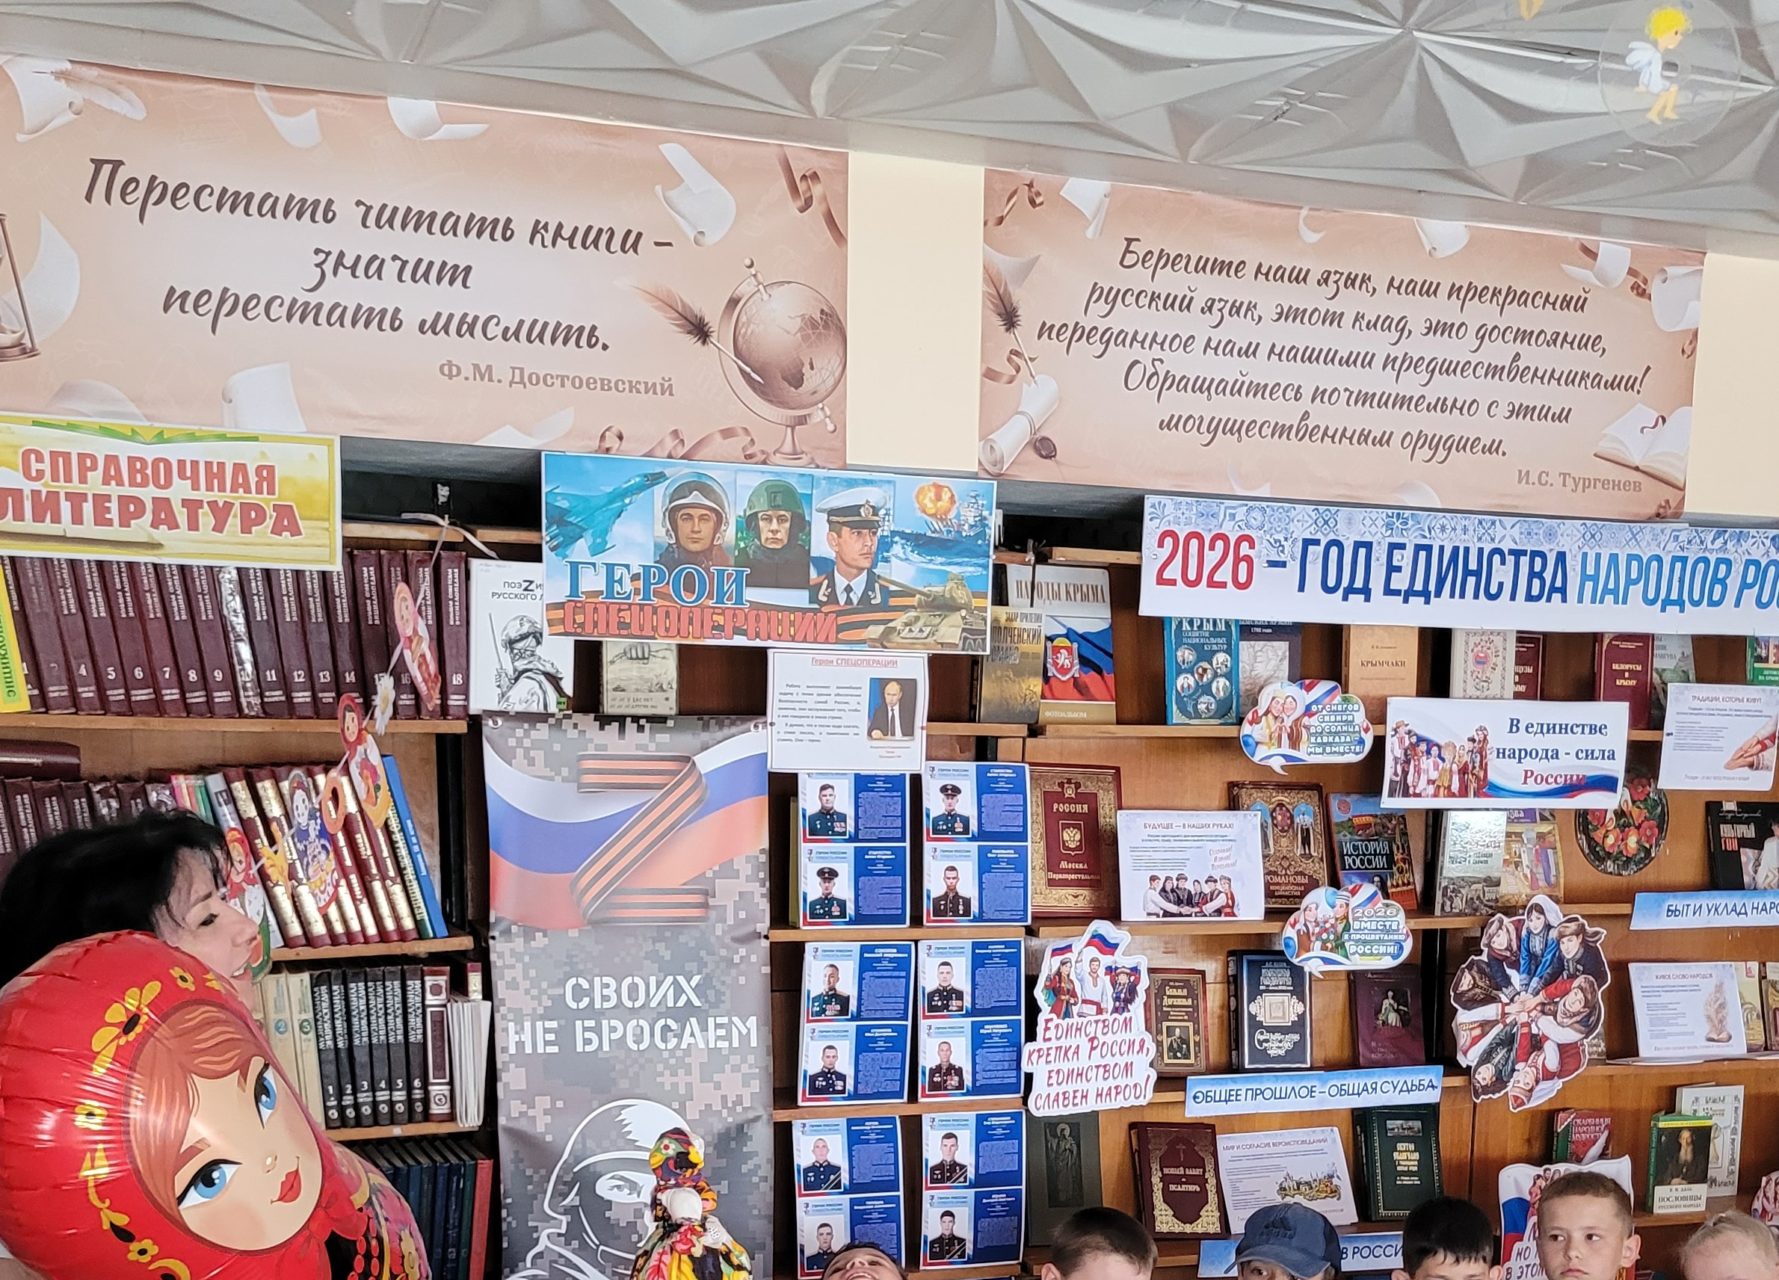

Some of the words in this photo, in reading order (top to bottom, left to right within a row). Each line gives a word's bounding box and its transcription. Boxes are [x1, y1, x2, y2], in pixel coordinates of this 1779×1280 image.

[83, 156, 337, 229] Перестать
[353, 195, 517, 244] читать
[529, 214, 643, 257] книги
[302, 243, 472, 293] значит
[1120, 237, 1246, 284] Берегите
[1254, 259, 1310, 289] наш
[1316, 262, 1379, 300] язык,
[1387, 274, 1440, 301] наш
[1447, 279, 1590, 319] прекрасный
[163, 281, 403, 338] перестать
[419, 309, 610, 352] мыслить.
[1083, 282, 1197, 323] русский
[1200, 294, 1264, 330] язык,
[1271, 300, 1345, 331] этот
[1352, 309, 1413, 345] клад,
[1420, 314, 1469, 342] это
[1472, 321, 1608, 361] достояние,
[1037, 317, 1198, 364] переданное
[1203, 335, 1261, 363] нам
[1267, 339, 1372, 372] нашими
[1380, 344, 1652, 399] предшественниками!
[438, 358, 503, 388] Ф.М.
[508, 364, 676, 400] Достоевский
[1122, 356, 1304, 408] Обращайтесь
[1309, 382, 1480, 424] почтительно
[1487, 398, 1500, 419] с
[1506, 398, 1573, 427] этим
[1156, 408, 1395, 454] могущественным
[1399, 427, 1509, 466] орудием.
[20, 448, 278, 497] СПРАВОЧНАЯ
[1516, 469, 1556, 488] И.С.
[1560, 472, 1643, 496] Тургенев
[0, 487, 304, 538] ЛИТЕРАТУРА
[1155, 528, 1257, 594] 2026
[1296, 537, 1375, 604] ГОД
[1382, 537, 1570, 608] ЕДИНСТВА
[1576, 552, 1730, 613] НАРОДОВ
[563, 558, 751, 607] ГЕРОИ
[491, 591, 537, 601] РУССКОГО
[1065, 583, 1106, 604] КРЫМА
[563, 600, 837, 644] СПЕЦОПЕРАЦИИ
[1182, 618, 1227, 631] КРЫМ
[811, 657, 834, 667] Герои
[836, 658, 898, 668] СПЕЦОПЕРАЦИИ
[1360, 659, 1406, 668] КРЫМЧАКИ
[78, 664, 87, 676] 4
[107, 667, 116, 680] 5
[134, 667, 144, 680] 6
[162, 667, 171, 679] 7
[188, 669, 197, 682] 8
[214, 669, 223, 682] 9
[293, 670, 305, 682] 12
[319, 671, 331, 682] 13
[345, 671, 356, 682] 14
[452, 673, 463, 685] 18
[1311, 704, 1322, 712] ОТ
[1325, 704, 1360, 712] СНЕГОВ
[1325, 724, 1360, 733] СОЛНЦА
[1508, 717, 1520, 735] В
[1525, 719, 1608, 737] единстве
[1495, 745, 1559, 763] народа
[1575, 745, 1616, 762] сила
[1522, 768, 1587, 787] России
[1053, 803, 1088, 813] РОССИЯ
[1143, 822, 1174, 830] БУДУЩЕЕ
[1342, 840, 1389, 854] ИСТОРИЯ
[1345, 856, 1388, 869] РОССИИ
[1265, 874, 1309, 884] РОМАНОВЫ
[1353, 908, 1398, 917] 2026
[1666, 903, 1691, 918] БЫТ
[1692, 903, 1703, 917] И
[1706, 902, 1748, 918] УКЛАД
[1353, 921, 1398, 930] ВМЕСТЕ
[1349, 945, 1398, 954] РОССИИ!
[565, 975, 702, 1010] СВОИХ
[508, 1021, 559, 1054] НЕ
[575, 1016, 758, 1052] БРОСАЕМ
[1026, 1043, 1080, 1067] КРЕПКА
[345, 1085, 352, 1094] 2
[361, 1081, 369, 1091] 3
[379, 1080, 386, 1089] 4
[397, 1079, 403, 1088] 5
[414, 1078, 421, 1088] 6
[328, 1085, 334, 1095] 1
[1193, 1088, 1242, 1105] ОБЩЕЕ
[1244, 1085, 1317, 1102] ПРОШЛОЕ
[1327, 1082, 1378, 1099] ОБЩАЯ
[1034, 1088, 1089, 1111] СЛАВЕН
[1658, 1194, 1702, 1203] ПОСЛОВИЦЫ
[1515, 1246, 1531, 1262] НО
